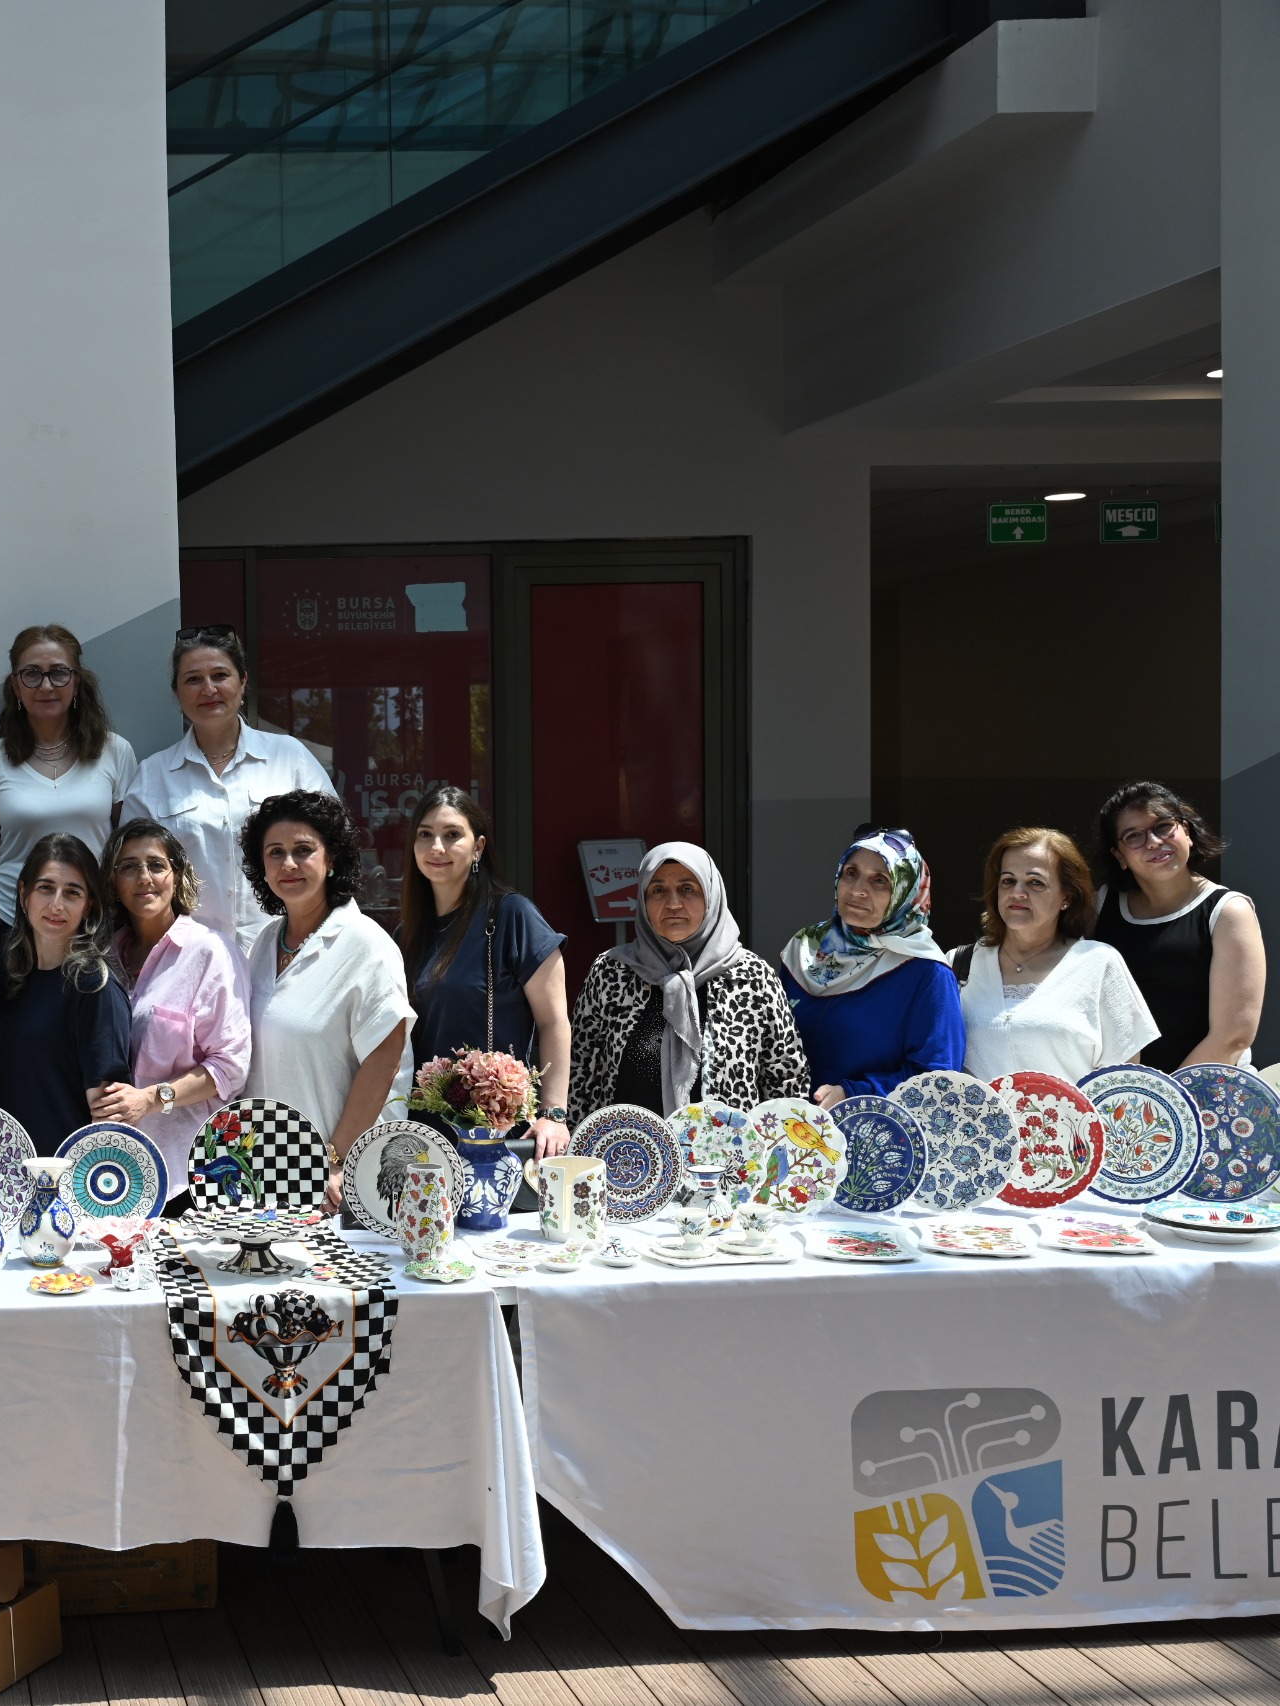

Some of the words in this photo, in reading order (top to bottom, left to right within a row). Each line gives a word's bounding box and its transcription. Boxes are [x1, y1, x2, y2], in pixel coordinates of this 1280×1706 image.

[337, 596, 396, 609] BURSA
[337, 619, 396, 631] BELEDİYESİ
[364, 773, 425, 787] BURSA
[1100, 1389, 1280, 1478] KAR
